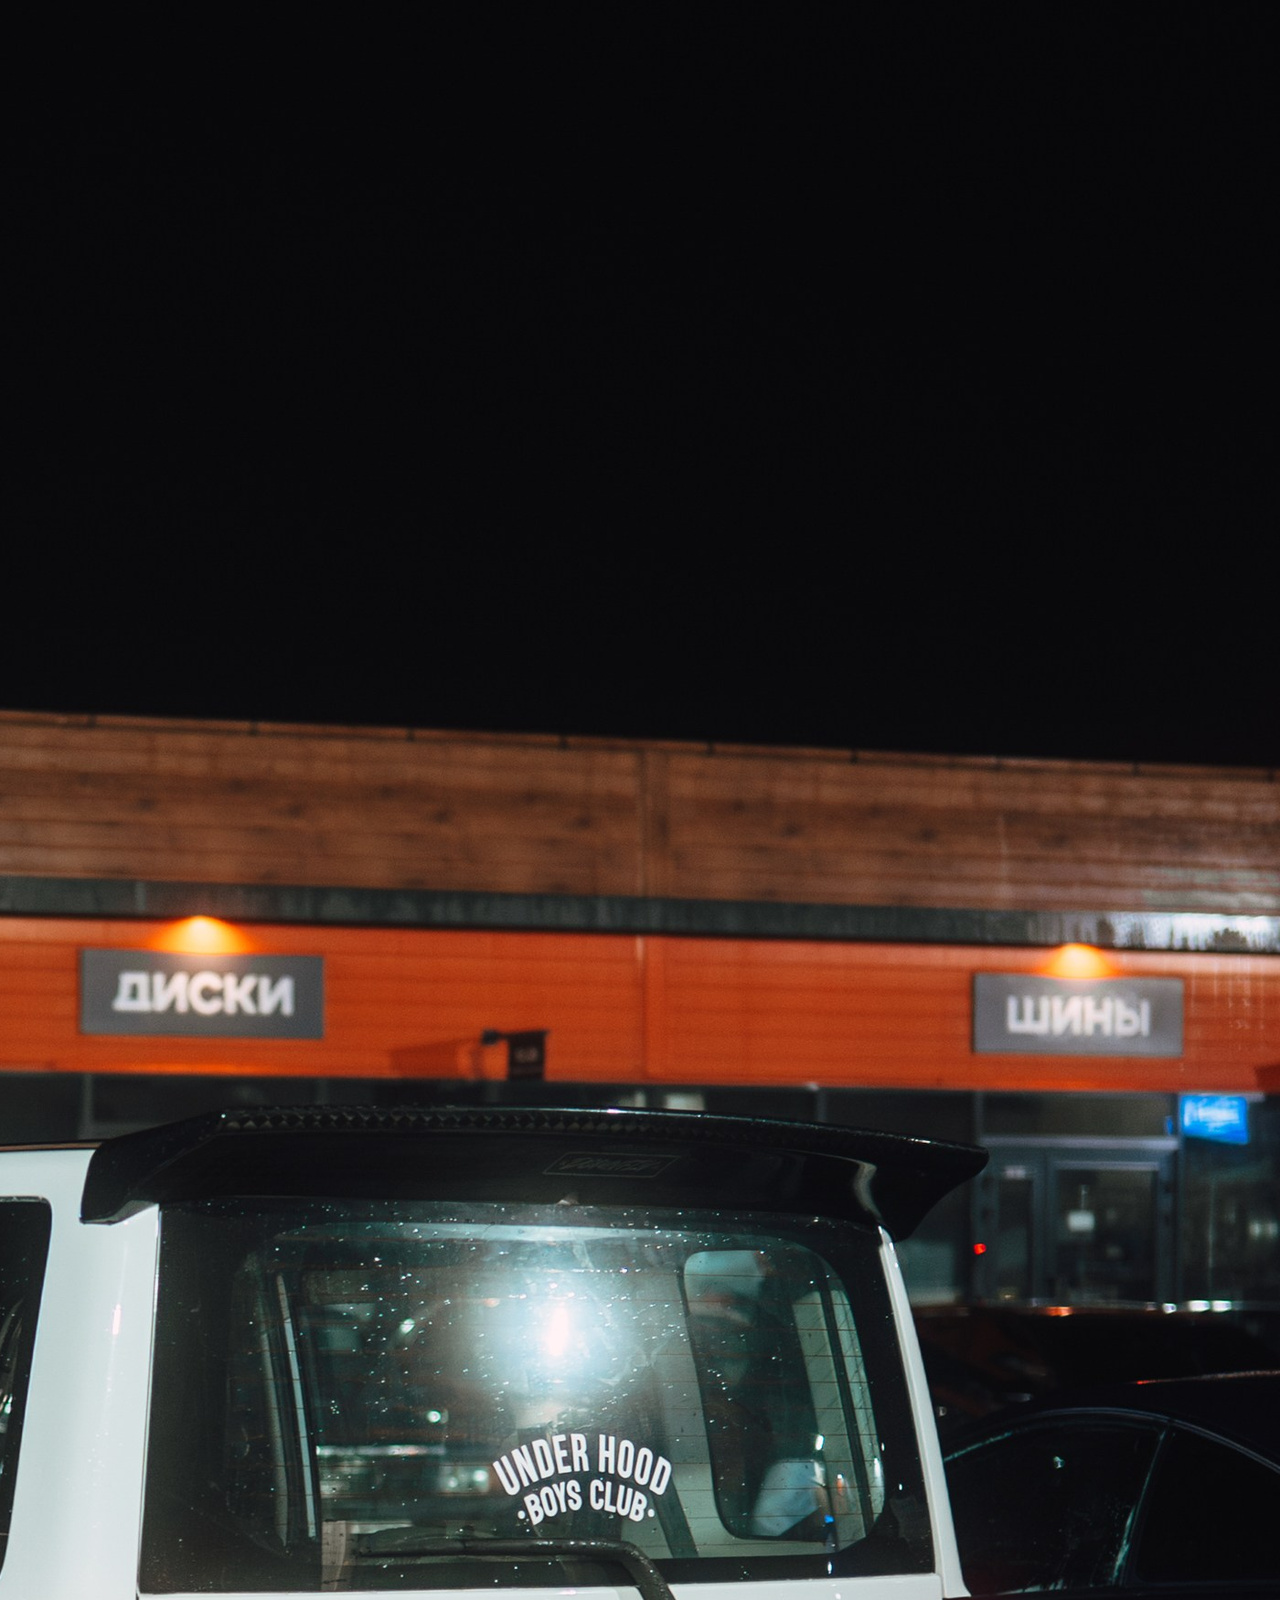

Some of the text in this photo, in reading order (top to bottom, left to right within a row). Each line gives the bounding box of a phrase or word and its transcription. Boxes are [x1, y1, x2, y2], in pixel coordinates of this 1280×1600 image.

[112, 970, 295, 1018] ДИСКИ
[1006, 994, 1151, 1037] ШИНЫ
[492, 1432, 672, 1496] UNDER HOOD
[523, 1478, 648, 1526] BOYS CLUB
